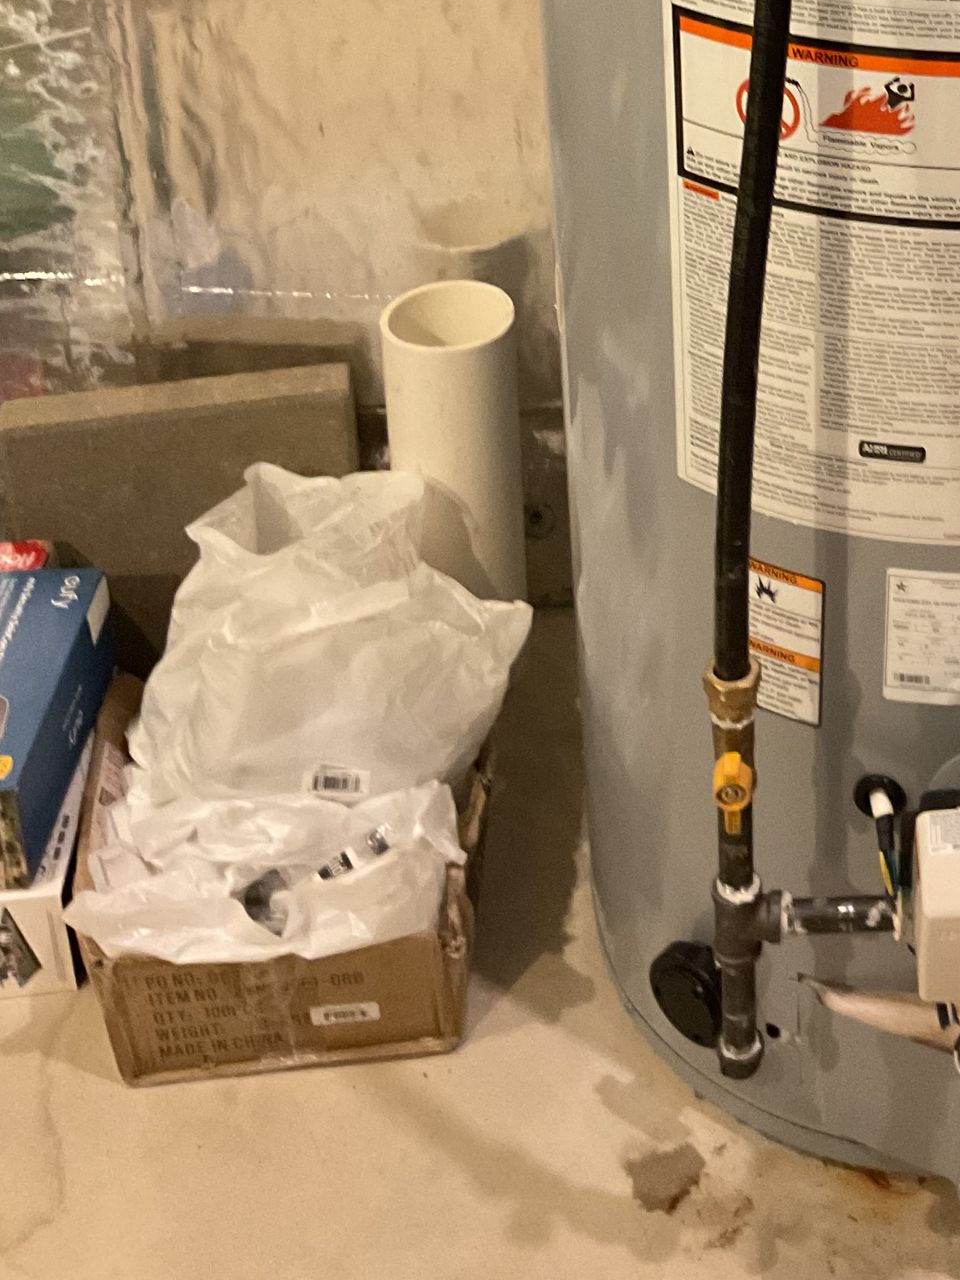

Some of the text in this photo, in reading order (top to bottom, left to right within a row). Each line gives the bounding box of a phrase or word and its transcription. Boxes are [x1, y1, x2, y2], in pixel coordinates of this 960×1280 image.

[792, 47, 859, 68] WARNING
[822, 134, 900, 152] Flammable Vapors
[51, 575, 80, 609] eufy
[148, 990, 191, 1006] ITEM
[158, 1042, 205, 1058] MADE
[211, 1038, 229, 1053] IN
